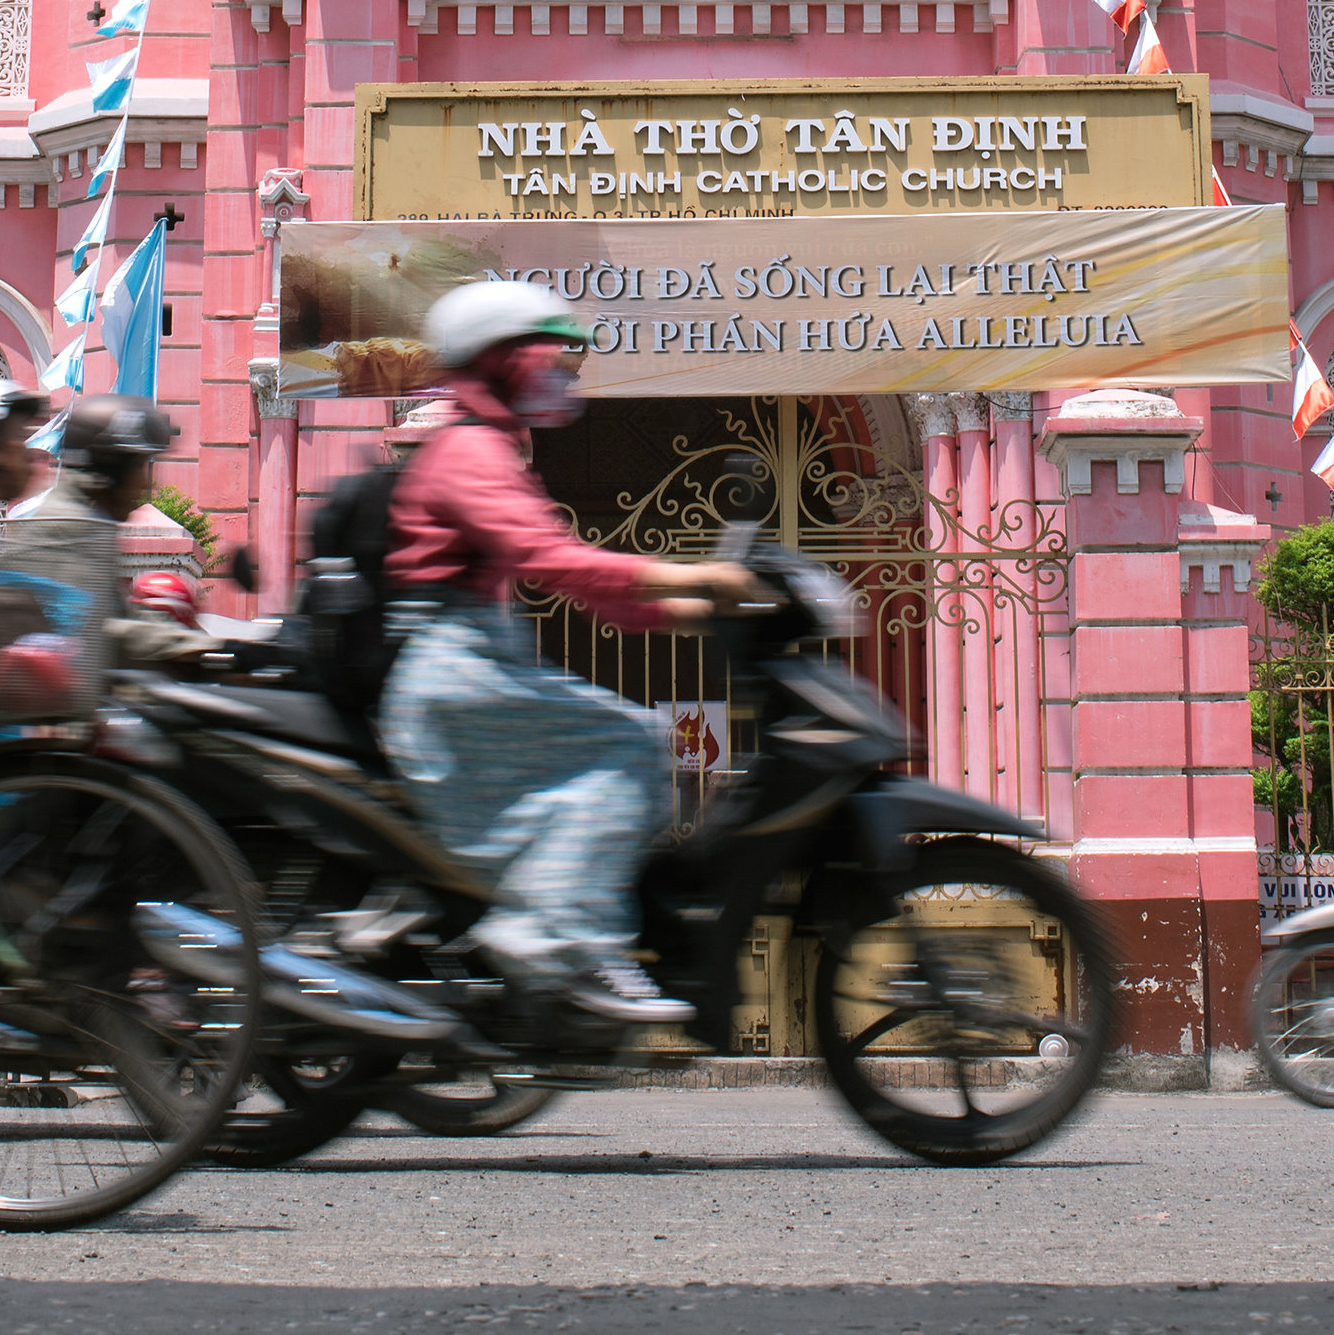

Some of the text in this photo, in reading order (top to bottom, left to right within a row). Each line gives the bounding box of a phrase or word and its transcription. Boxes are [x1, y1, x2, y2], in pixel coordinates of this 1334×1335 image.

[477, 107, 1087, 160] NHÀ THỜ TÂN ĐỊNH
[502, 167, 1063, 200] TÂN ĐỊNH CATHOLIC CHURCH
[745, 208, 795, 218] MINH
[655, 260, 722, 299] ĐÃ
[734, 253, 866, 299] SỐNG
[876, 263, 956, 305] LẠI
[967, 253, 1097, 302] THẬT
[651, 313, 785, 353] PHÁN
[796, 311, 904, 351] HỨA
[914, 312, 1143, 350] ALLELUIA
[1263, 882, 1296, 898] VUI
